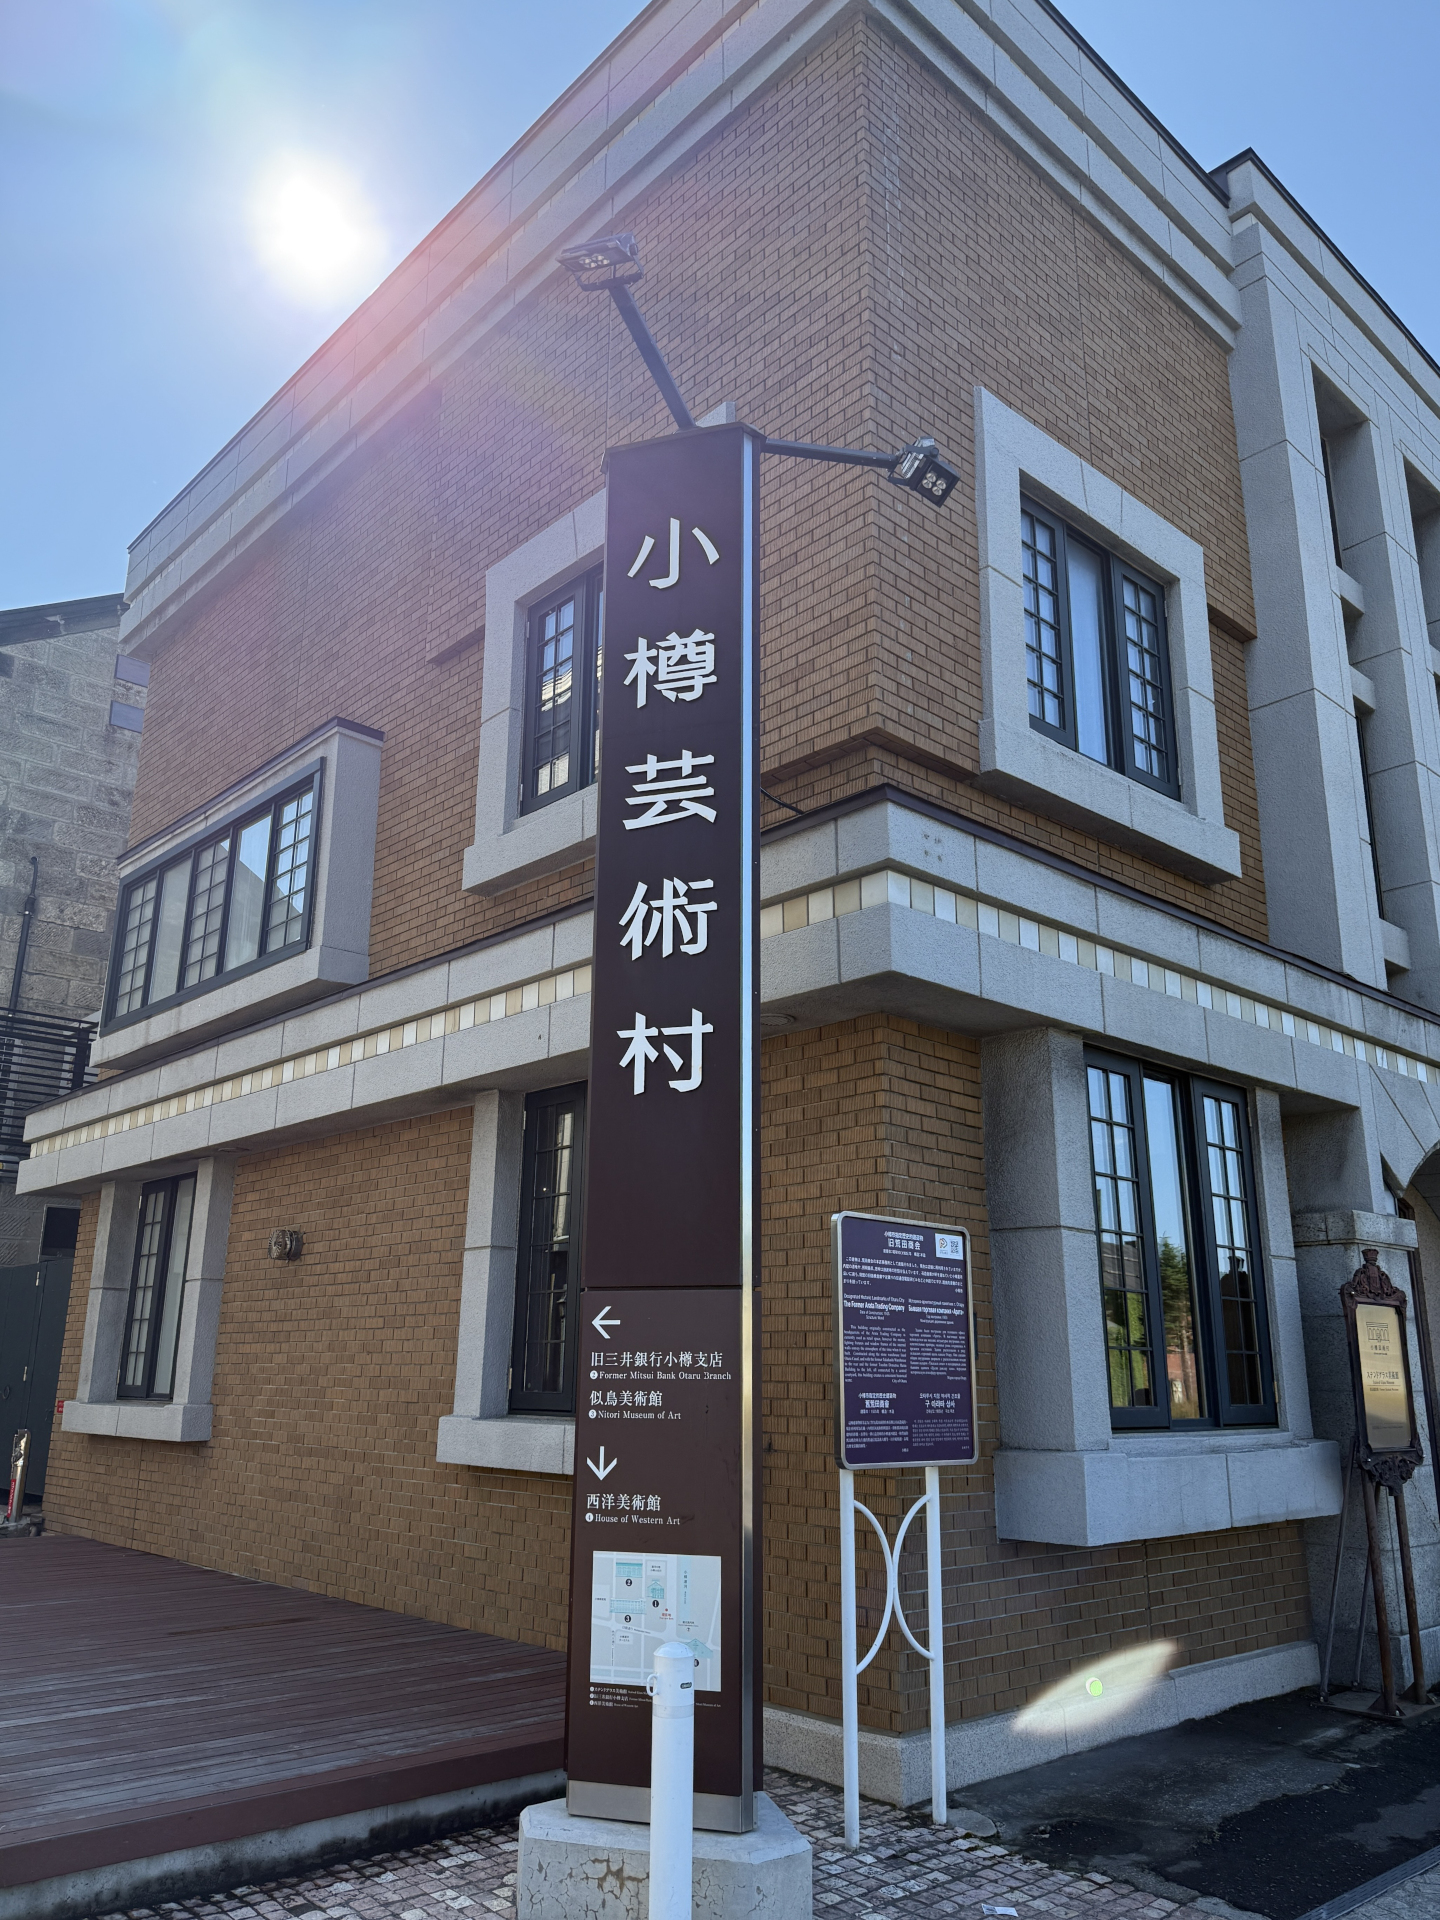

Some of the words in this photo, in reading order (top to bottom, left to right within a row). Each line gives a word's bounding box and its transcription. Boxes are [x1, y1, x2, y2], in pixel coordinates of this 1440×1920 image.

[616, 517, 720, 1096] 小樽芸術村
[590, 1351, 723, 1368] 旧三井銀行小樽支店
[599, 1371, 627, 1380] Former
[630, 1371, 654, 1380] Mitsui
[656, 1371, 676, 1380] Bank
[678, 1372, 701, 1380] Otaru
[703, 1371, 732, 1380] Branch
[589, 1390, 663, 1407] 似鳥美術館
[598, 1410, 620, 1419] Nitori
[622, 1410, 655, 1420] Museum
[657, 1411, 665, 1420] of
[668, 1411, 681, 1420] Art
[586, 1493, 661, 1512] 西洋美術館
[595, 1513, 618, 1523] House
[621, 1514, 629, 1523] of
[631, 1515, 664, 1525] Western
[666, 1516, 681, 1525] Art
